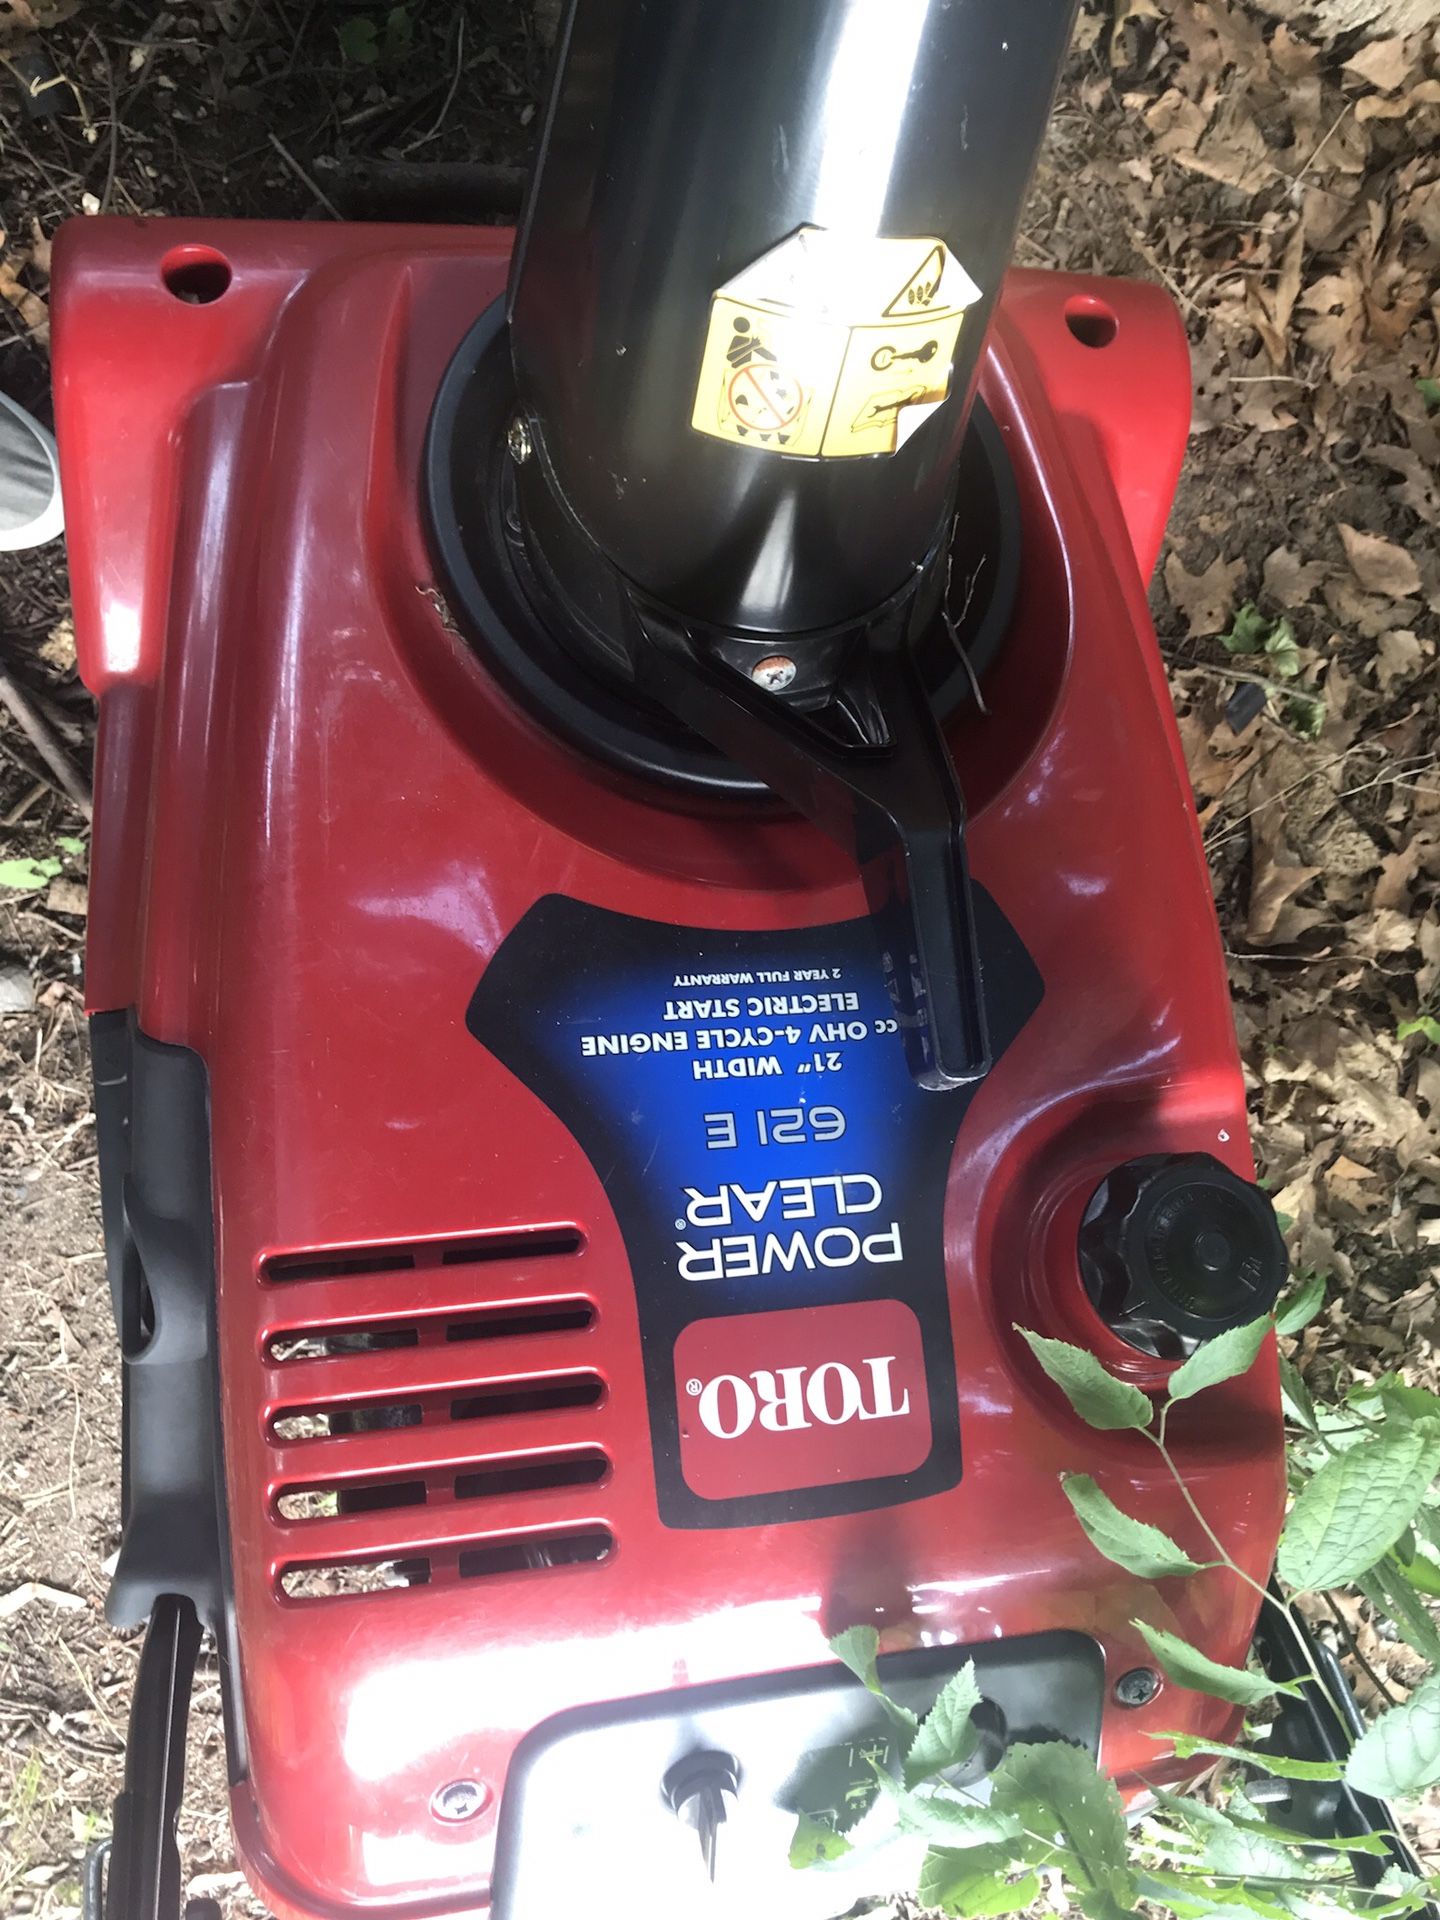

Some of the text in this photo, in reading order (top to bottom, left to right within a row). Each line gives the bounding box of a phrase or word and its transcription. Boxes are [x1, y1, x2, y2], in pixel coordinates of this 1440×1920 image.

[674, 969, 841, 986] 2 YEAR FULL WARRANTY
[664, 993, 858, 1020] ELECTRIC START
[582, 1032, 688, 1055] ENGINE
[696, 1026, 801, 1049] 4-CYCLE
[810, 1022, 867, 1042] OHV
[693, 1057, 782, 1079] WIDTH
[704, 1106, 845, 1149] 621 E
[675, 1220, 903, 1281] POWER
